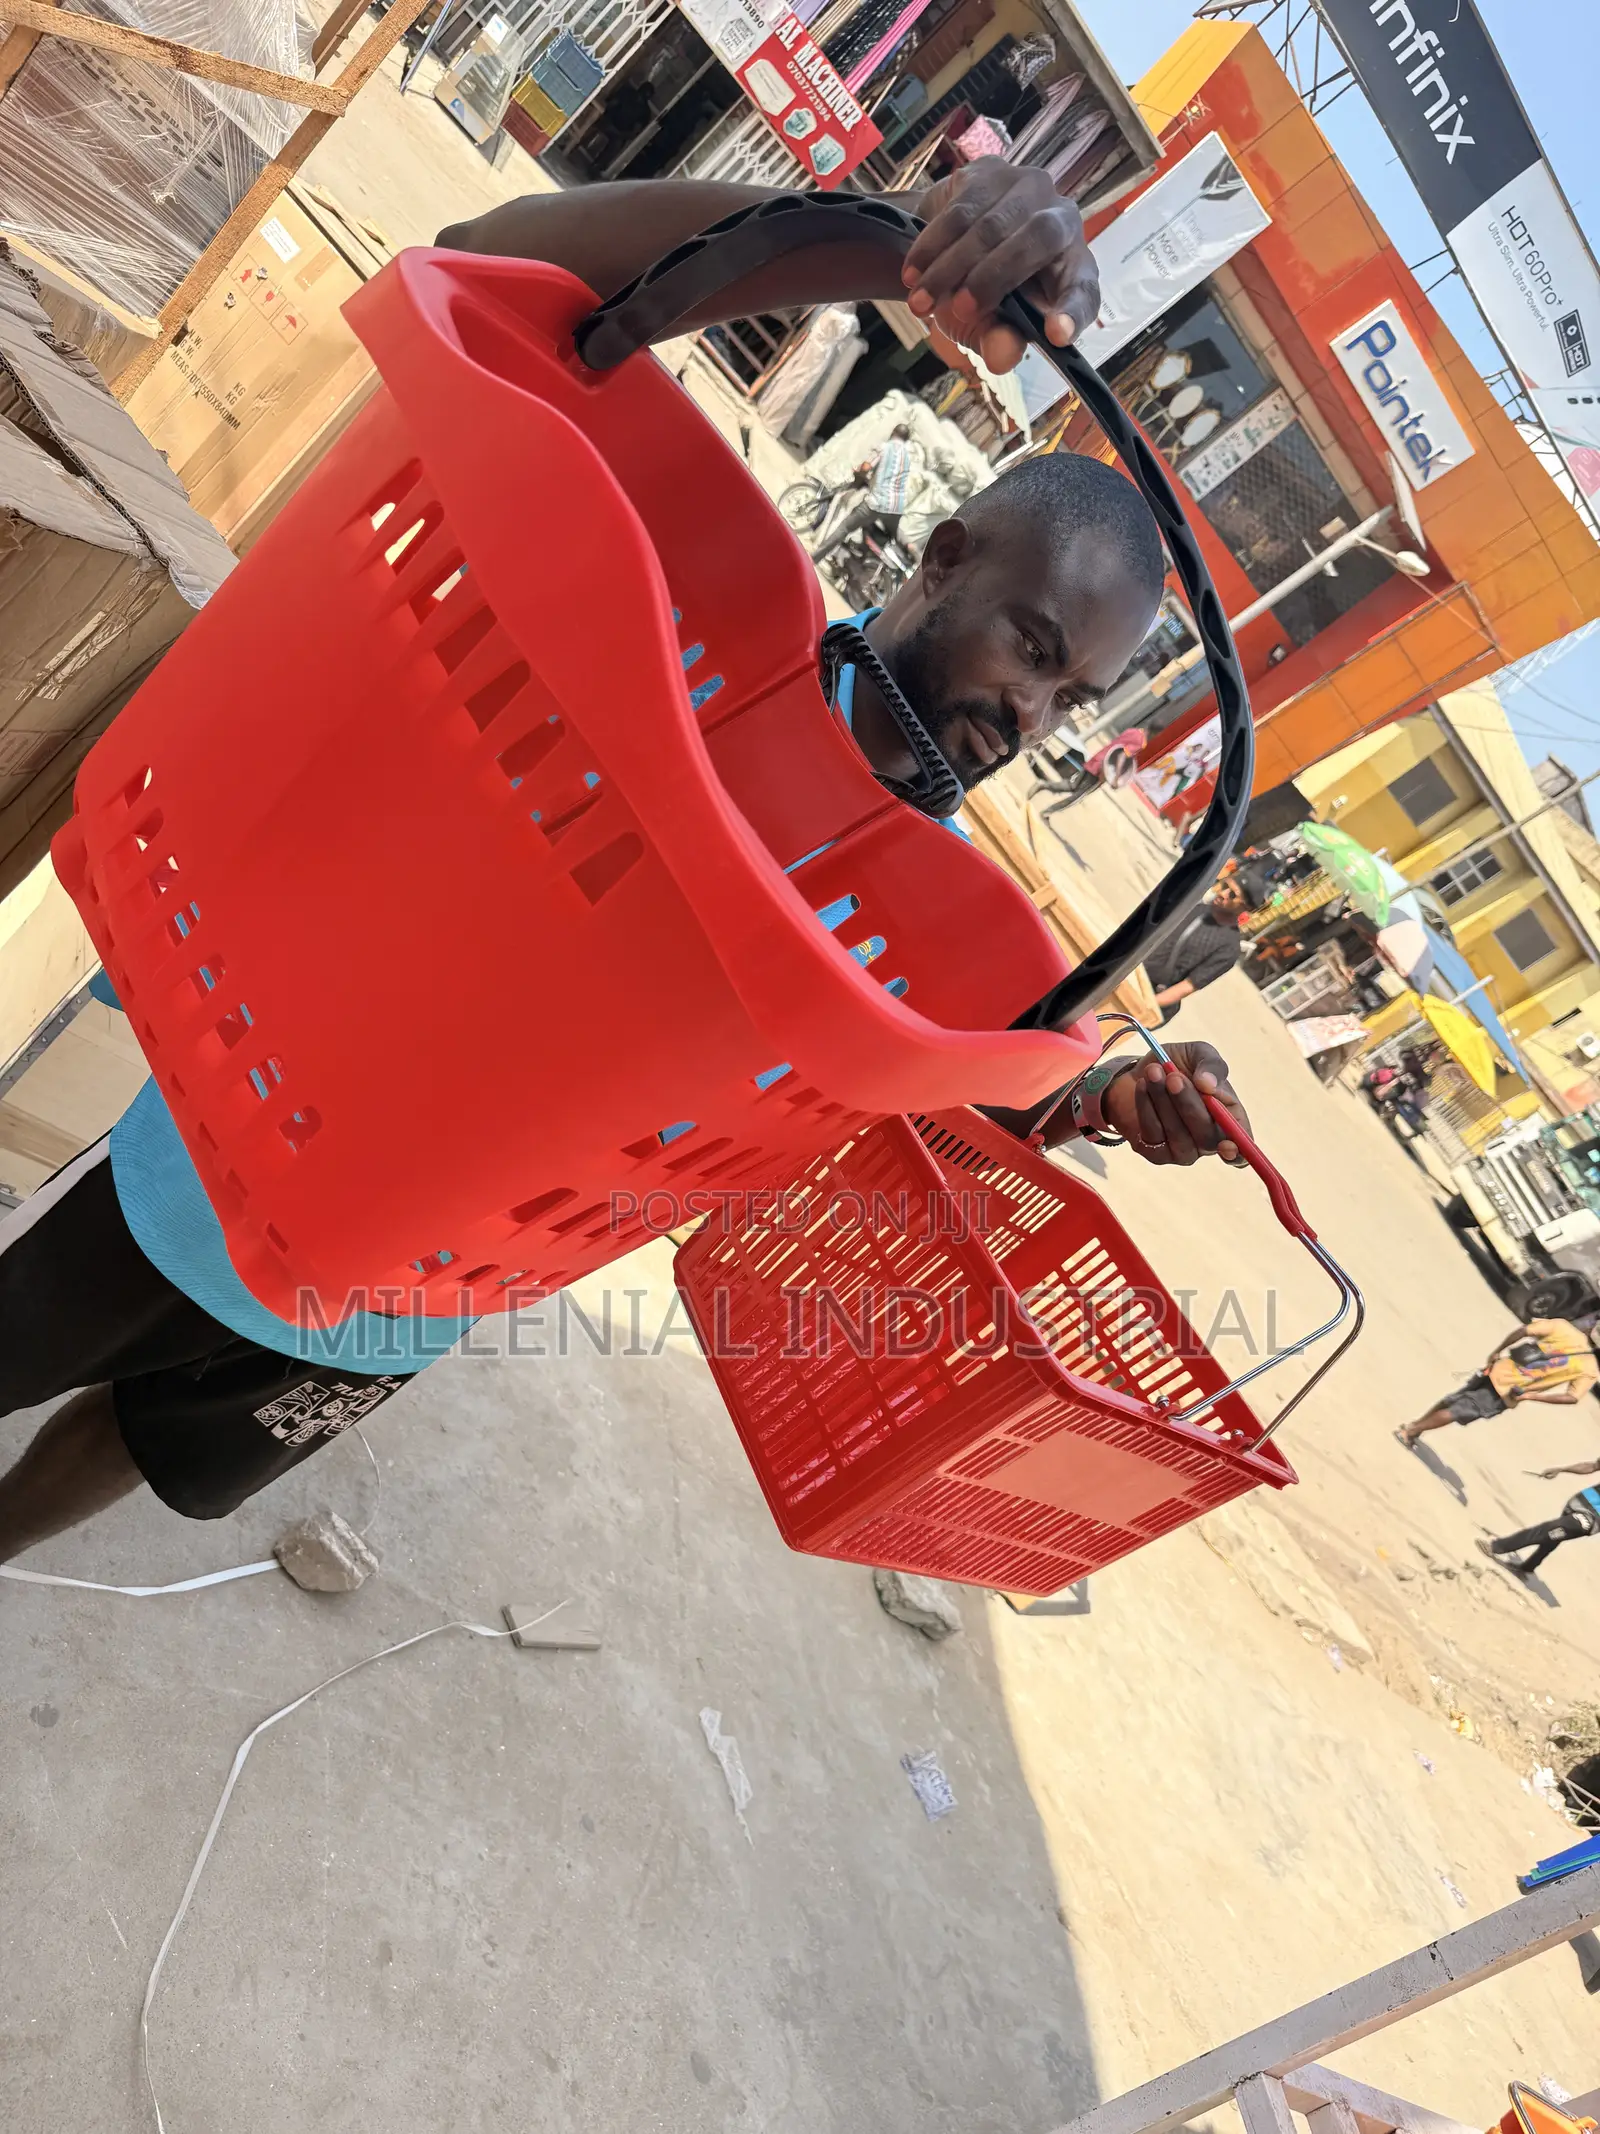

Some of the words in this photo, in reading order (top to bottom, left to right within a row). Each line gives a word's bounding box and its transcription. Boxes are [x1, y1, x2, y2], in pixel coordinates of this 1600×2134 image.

[739, 0, 764, 28] 13890
[793, 40, 863, 132] MACHINER
[1501, 205, 1535, 251] HOT
[1145, 244, 1172, 279] Power
[1157, 233, 1179, 264] More
[1488, 221, 1503, 247] Ultra
[1512, 268, 1527, 293] Ultra
[225, 391, 237, 406] KG
[233, 382, 246, 397] KG
[1345, 320, 1453, 482] Pointek
